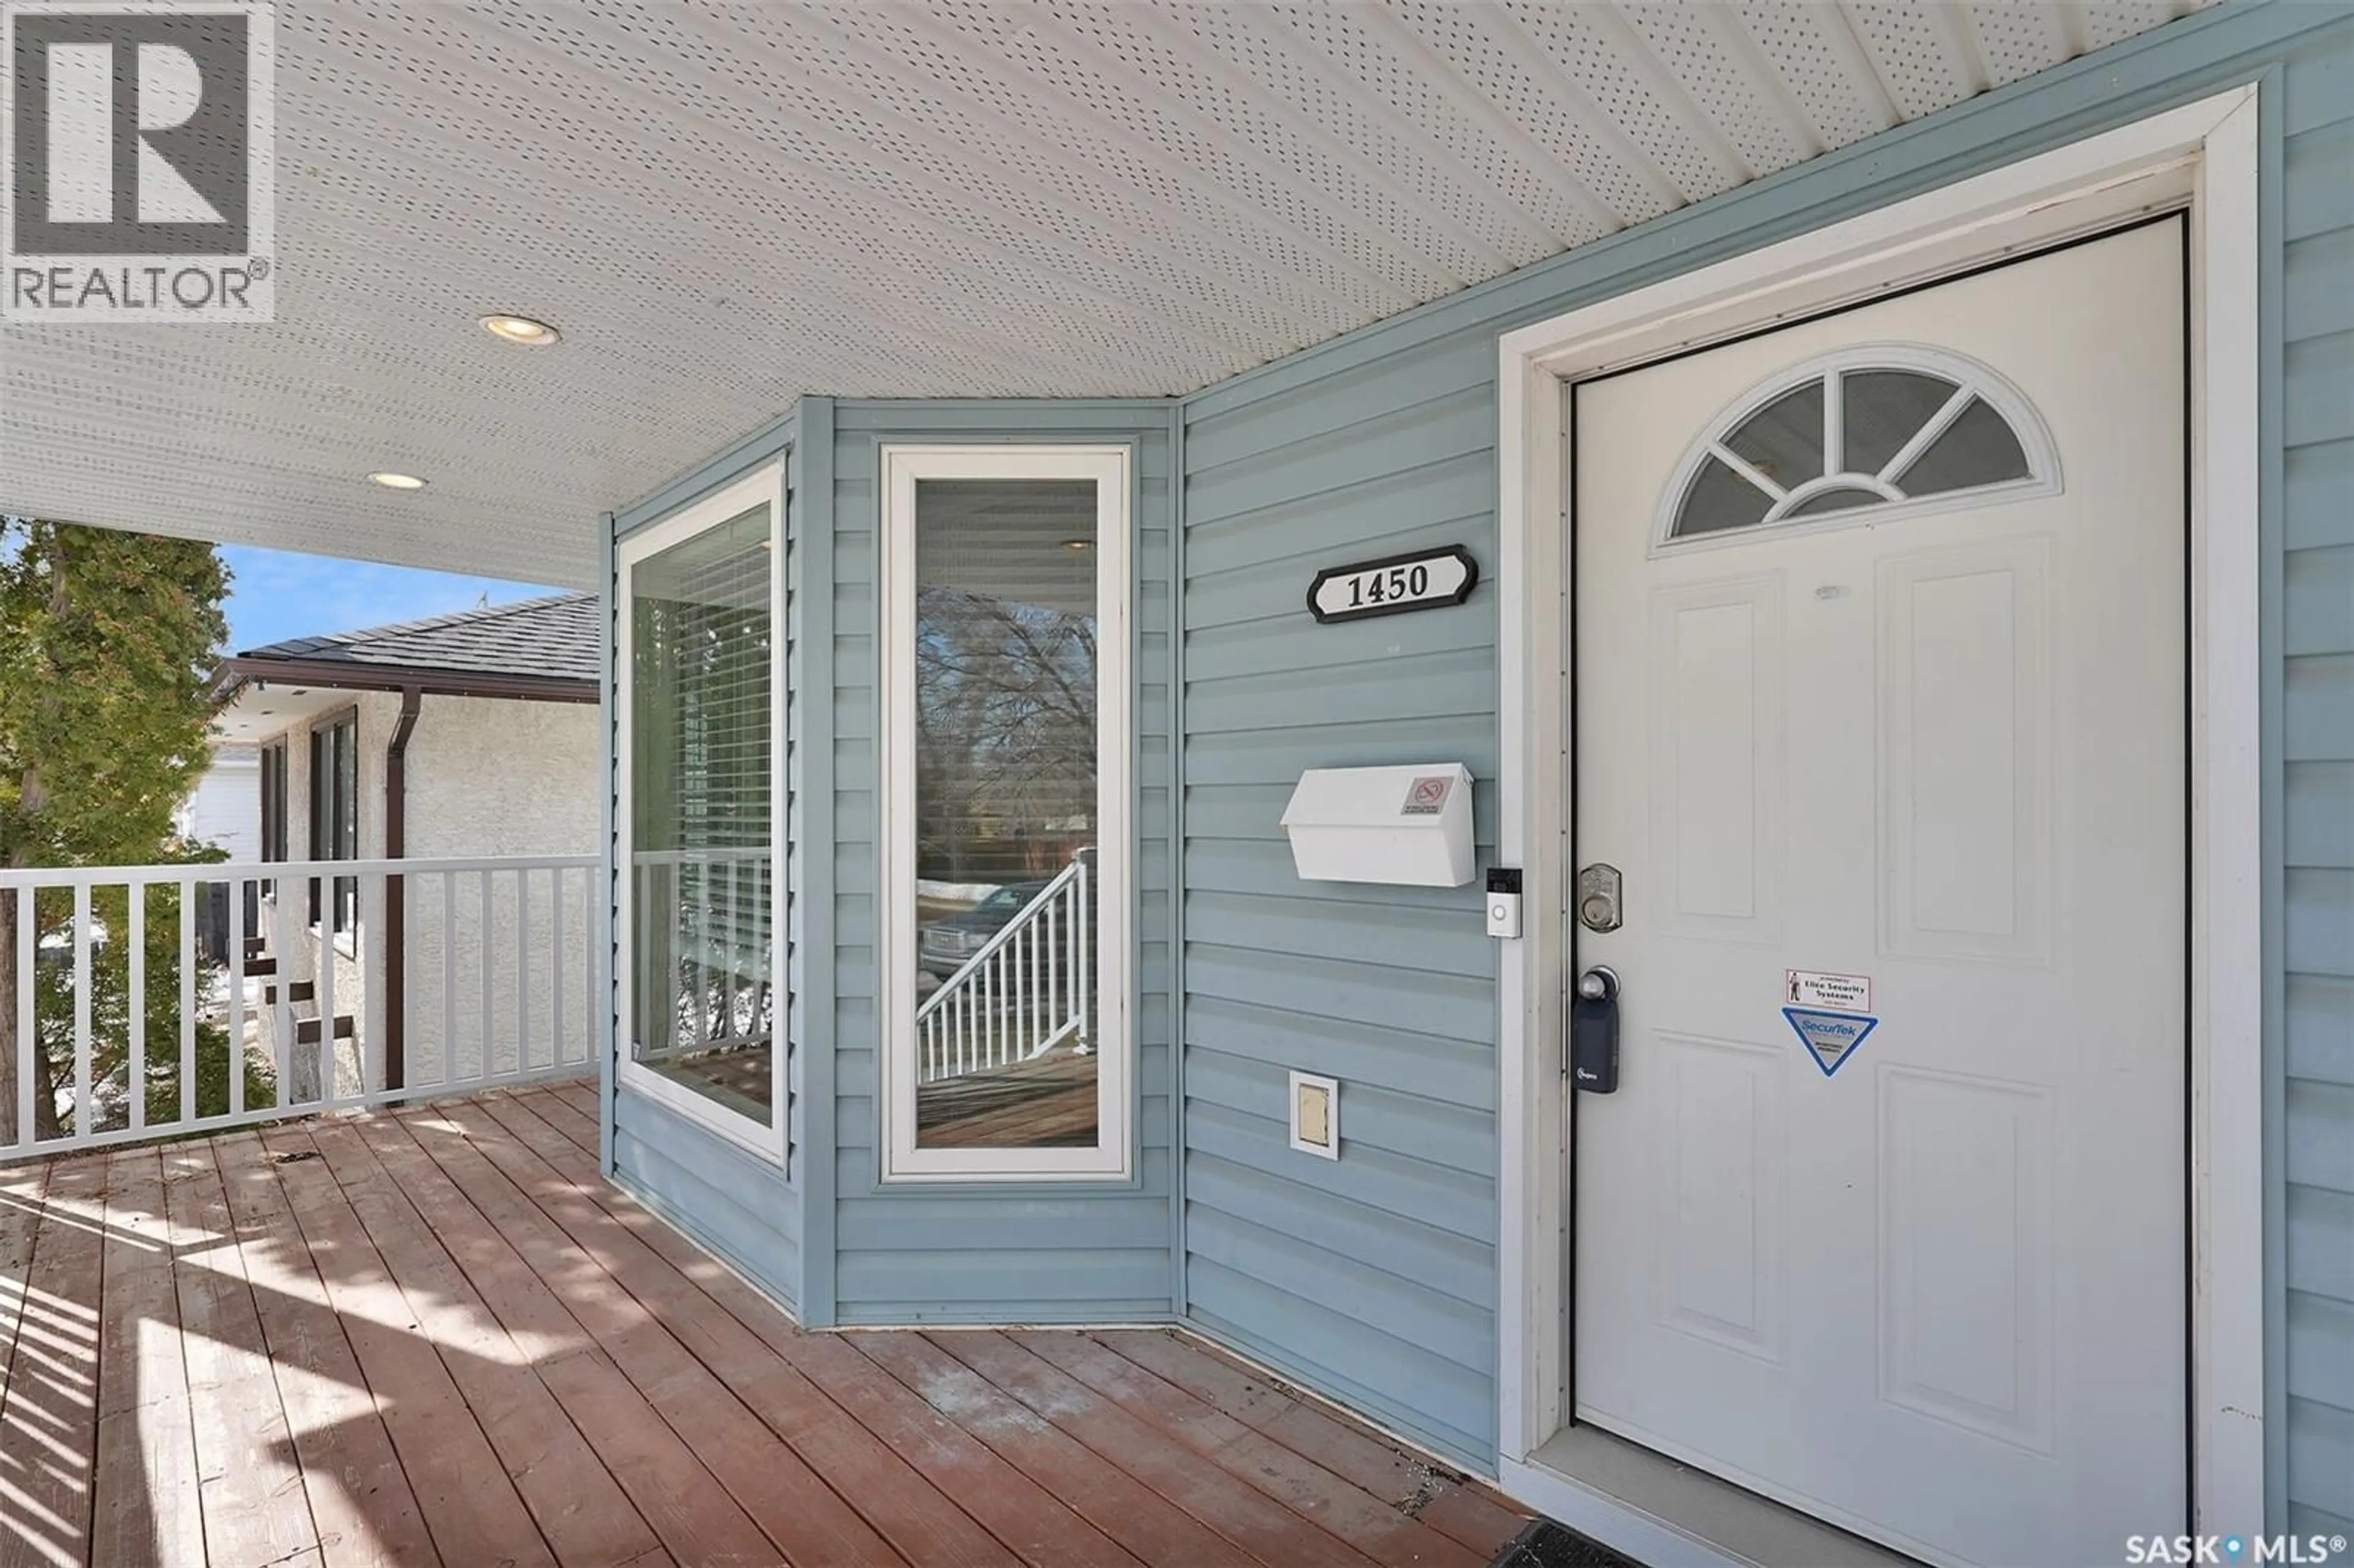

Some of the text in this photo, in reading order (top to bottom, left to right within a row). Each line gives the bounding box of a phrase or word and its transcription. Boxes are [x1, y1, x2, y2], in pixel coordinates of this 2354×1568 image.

[1348, 565, 1427, 607] 1450
[1827, 983, 1864, 994] Security
[1816, 990, 1854, 1000] Systems
